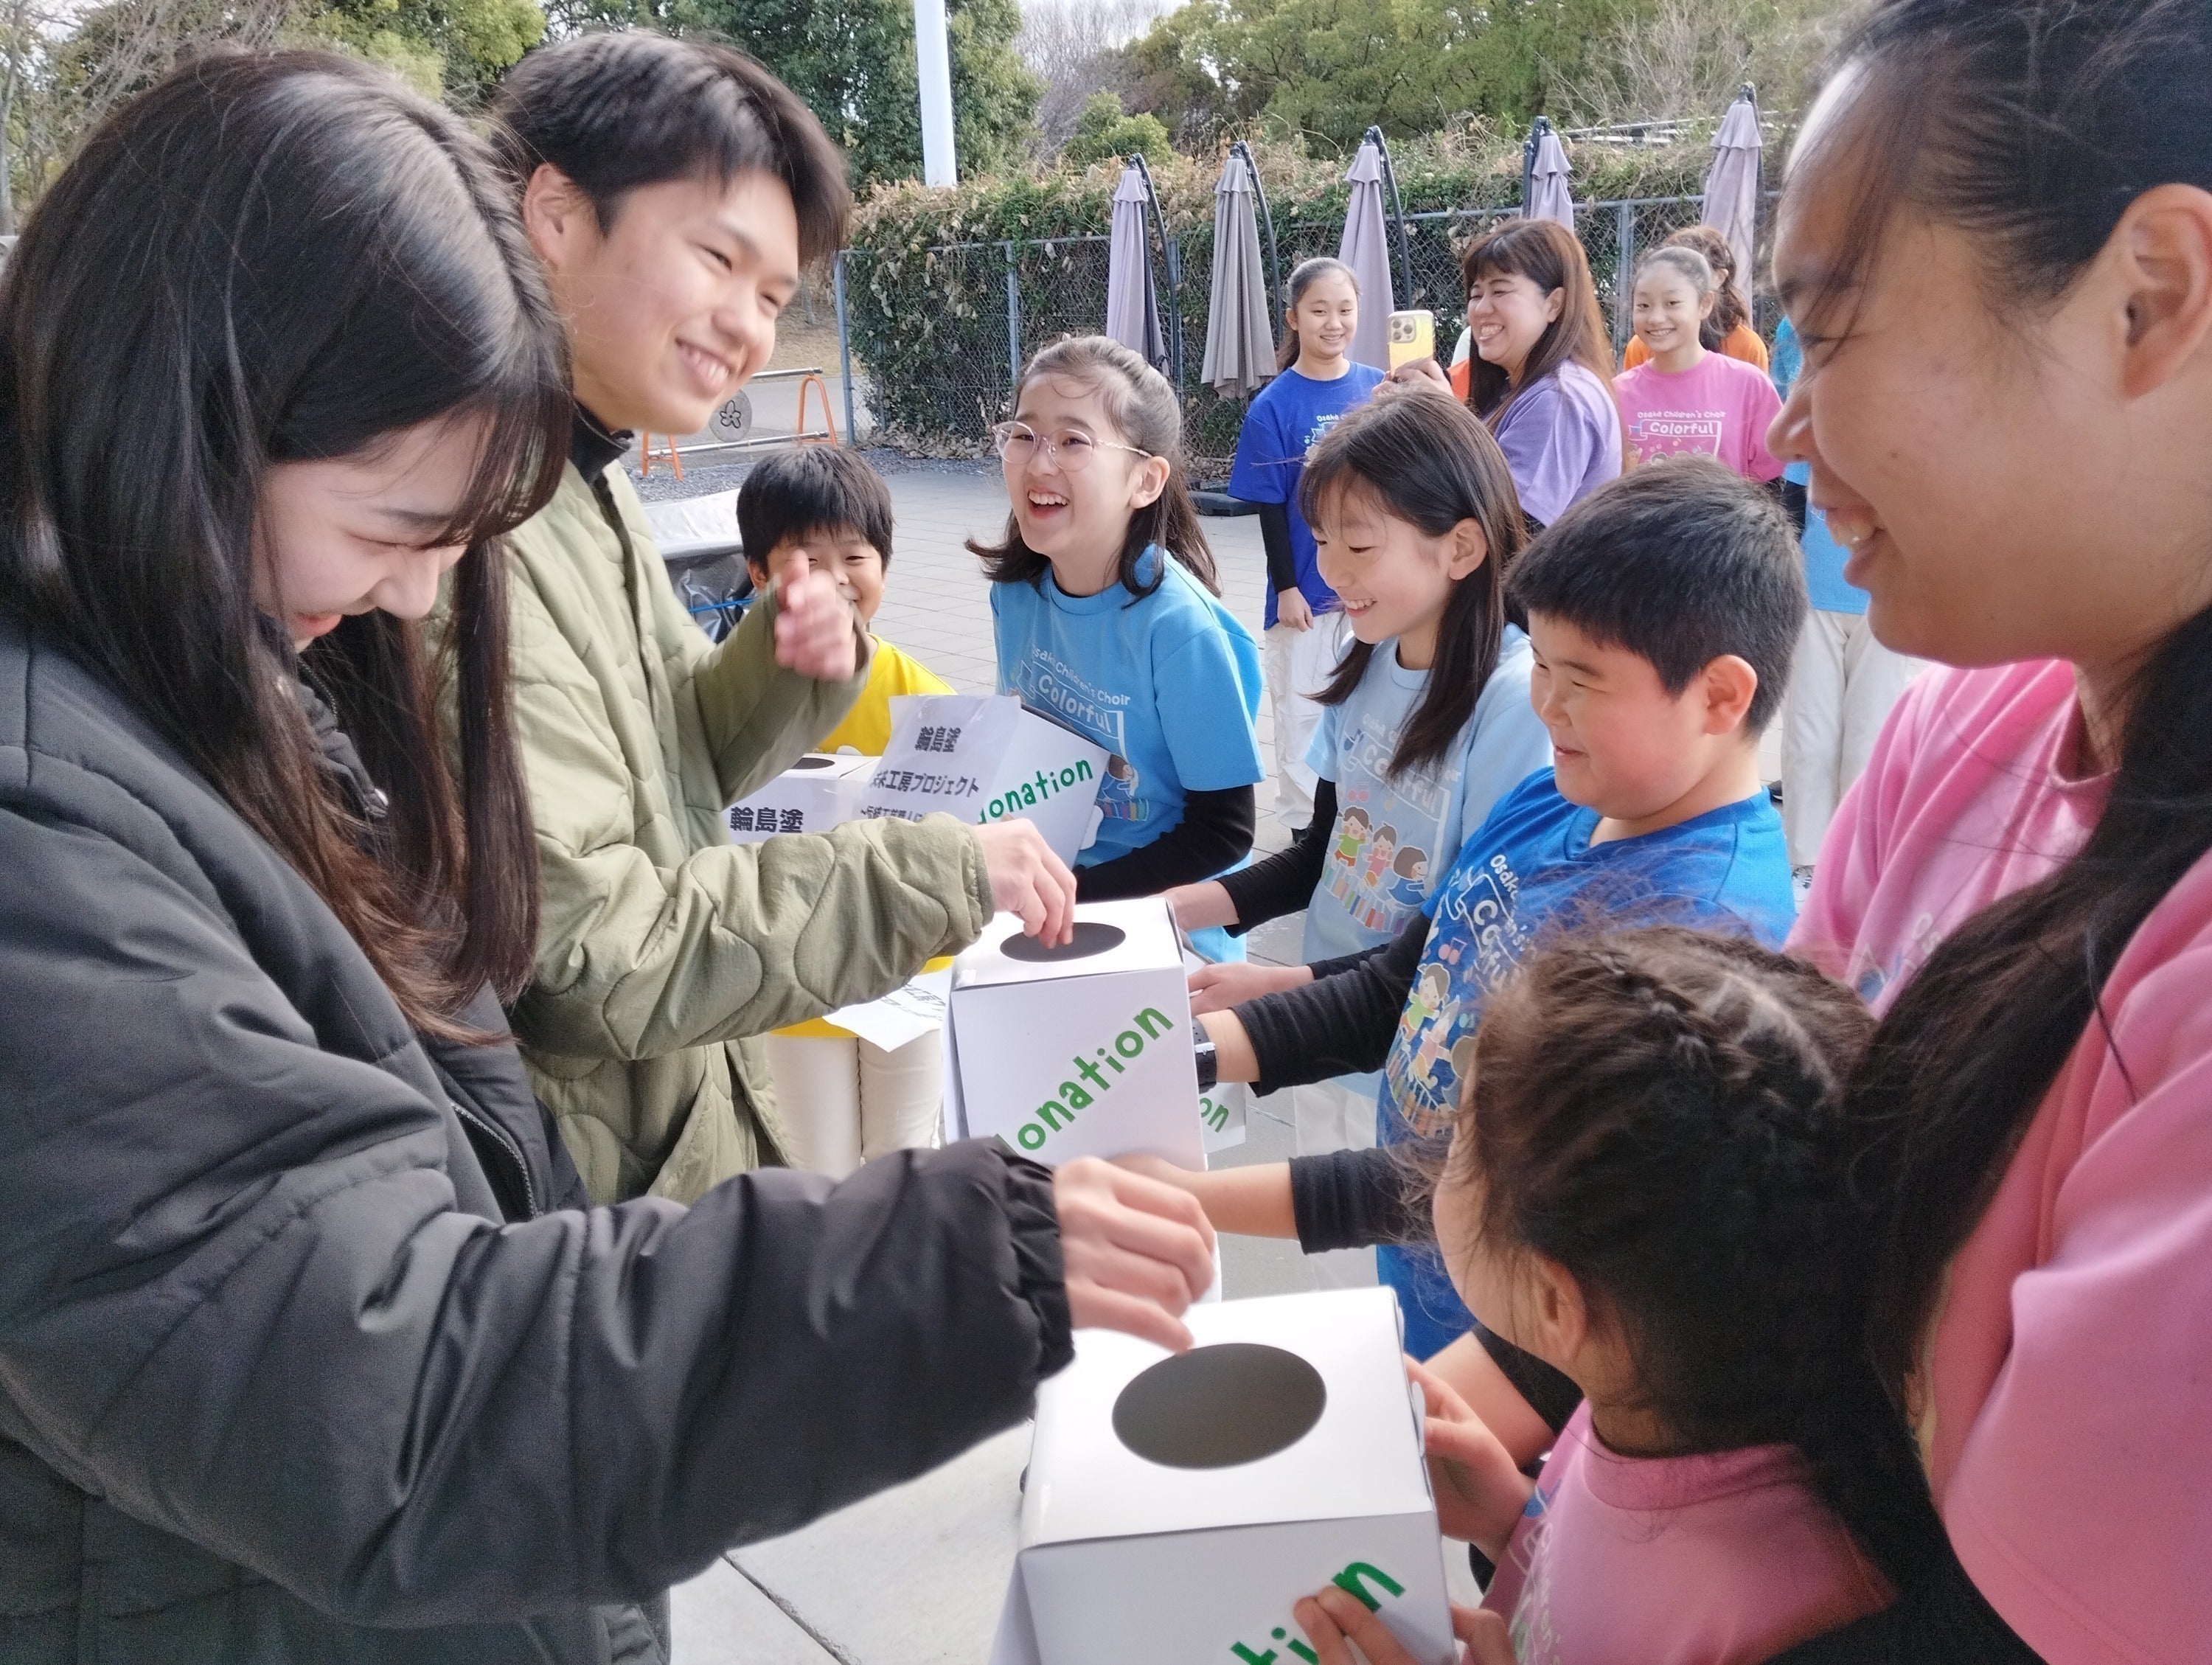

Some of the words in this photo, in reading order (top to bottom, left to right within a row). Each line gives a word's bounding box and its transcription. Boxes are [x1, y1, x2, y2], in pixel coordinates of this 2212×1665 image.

[1650, 421, 1714, 434] Colorful
[1038, 674, 1112, 734] Colorful
[1097, 689, 1131, 706] Choir
[914, 726, 961, 753] 輪島塗
[729, 806, 804, 833] 輪島塗
